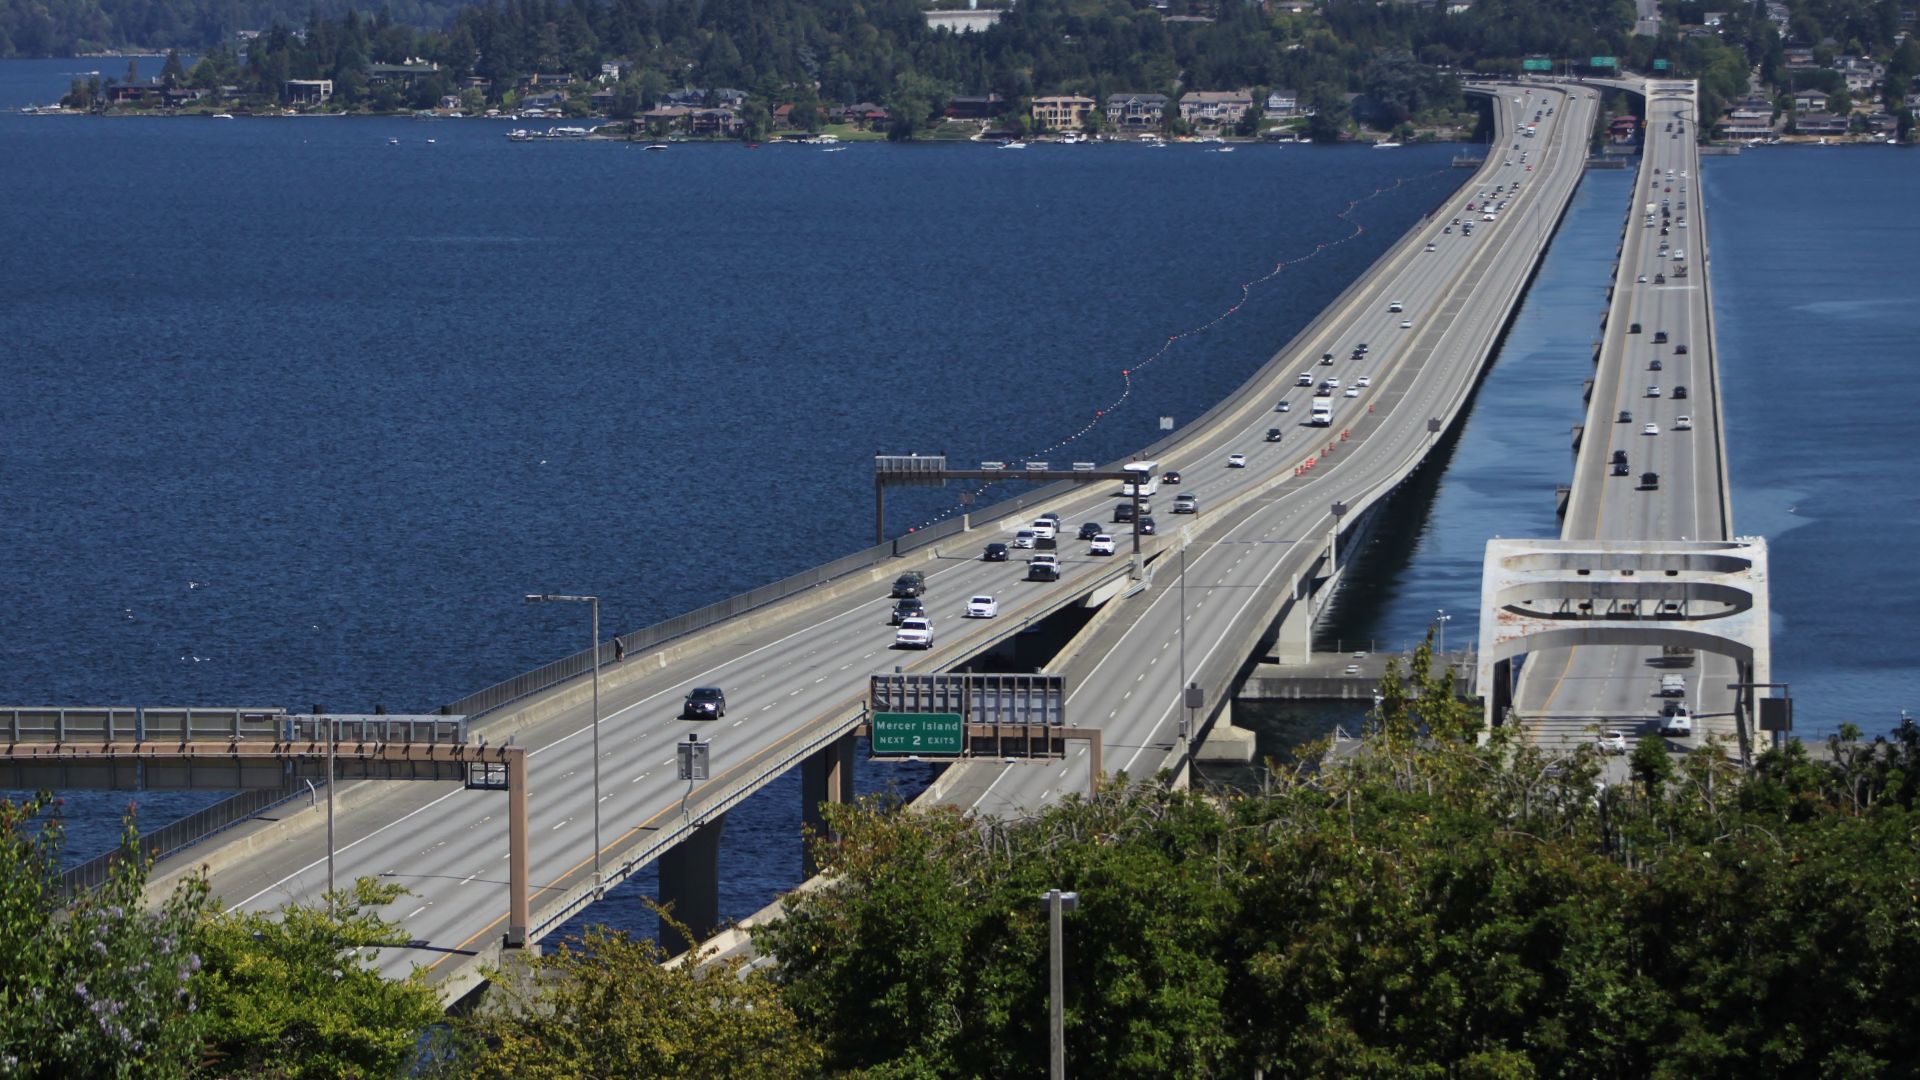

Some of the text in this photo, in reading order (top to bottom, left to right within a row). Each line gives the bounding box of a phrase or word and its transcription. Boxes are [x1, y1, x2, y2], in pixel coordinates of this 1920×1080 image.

[876, 721, 959, 730] Mercer Island
[880, 735, 955, 746] NEXT 2 EXITS
